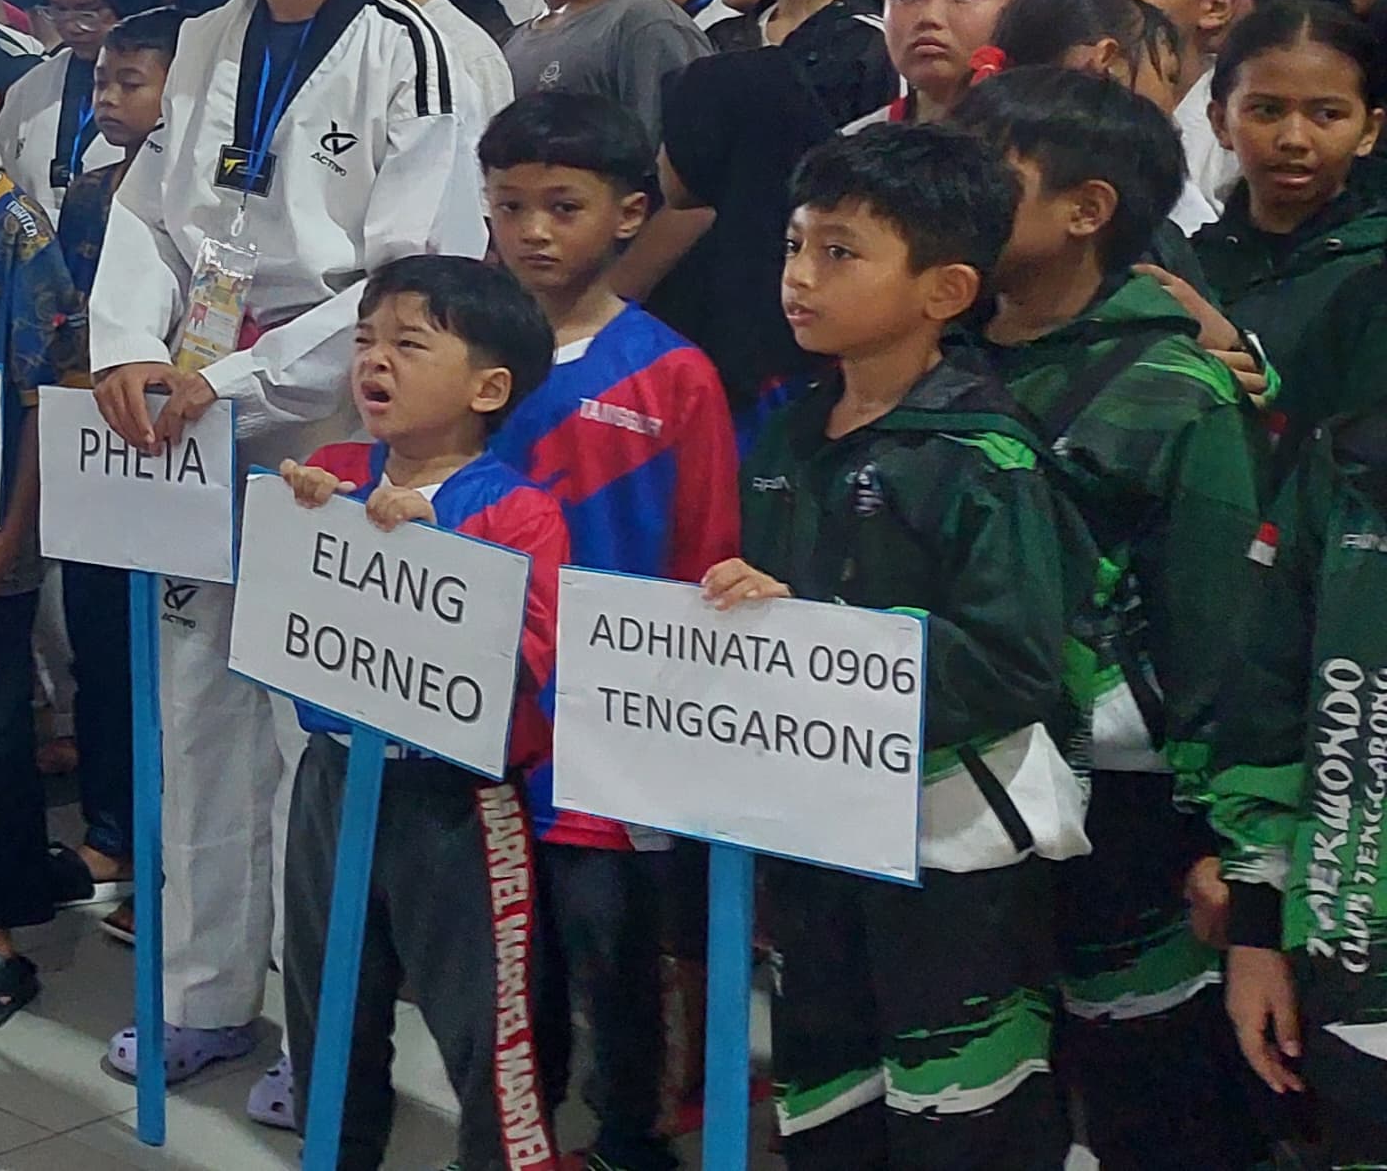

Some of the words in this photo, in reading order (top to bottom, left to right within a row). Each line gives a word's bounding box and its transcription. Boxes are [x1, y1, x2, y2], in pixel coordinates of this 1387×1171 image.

[311, 530, 468, 625] ELANG
[284, 611, 483, 724] BORNEO
[588, 612, 796, 679] ADHINATA
[807, 644, 917, 696] 0906
[596, 685, 914, 775] TENGGARONG
[476, 782, 531, 916] MARVEL
[1305, 656, 1366, 960] TAEKWONDO
[1338, 891, 1375, 975] CLUB
[496, 1043, 552, 1171] MARVEL
